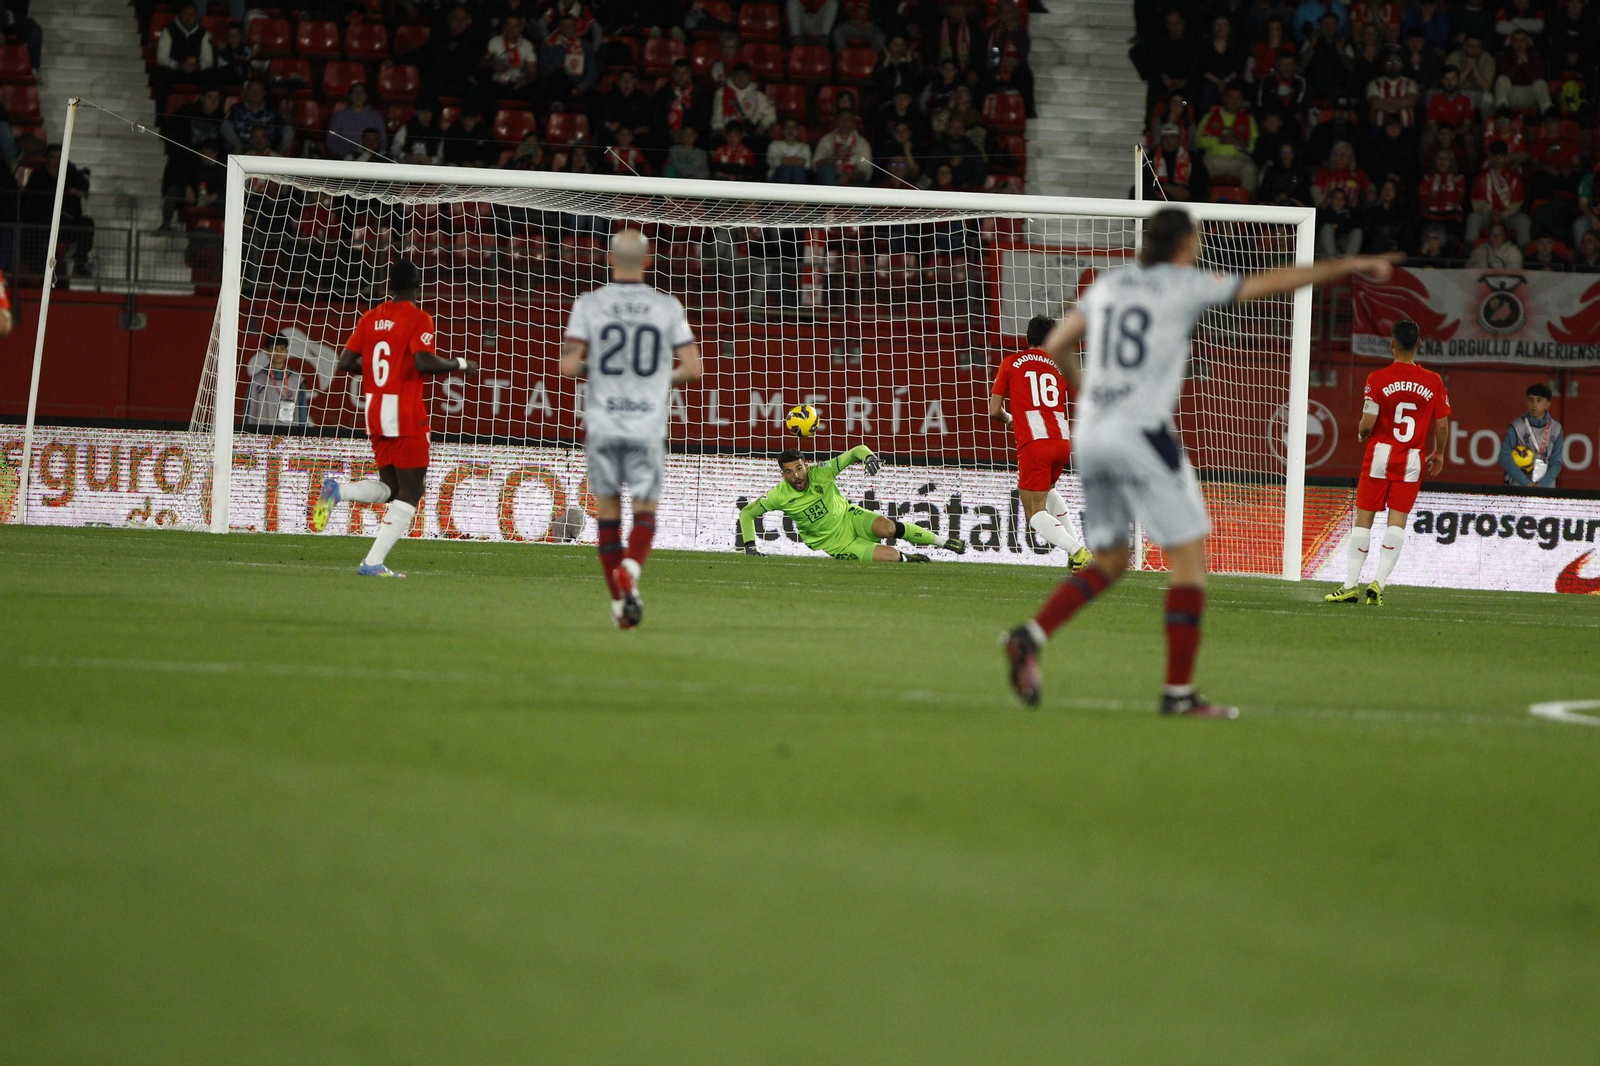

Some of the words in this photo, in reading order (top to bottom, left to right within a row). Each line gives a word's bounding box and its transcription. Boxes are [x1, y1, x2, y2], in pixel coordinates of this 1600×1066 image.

[374, 319, 395, 331] LOPY
[1102, 305, 1151, 369] 18
[372, 340, 391, 388] 6
[600, 322, 662, 377] 20
[1448, 338, 1511, 356] ORGULLO
[1024, 370, 1060, 408] 16
[1382, 381, 1434, 402] ROBERTONE
[1392, 401, 1418, 443] 5
